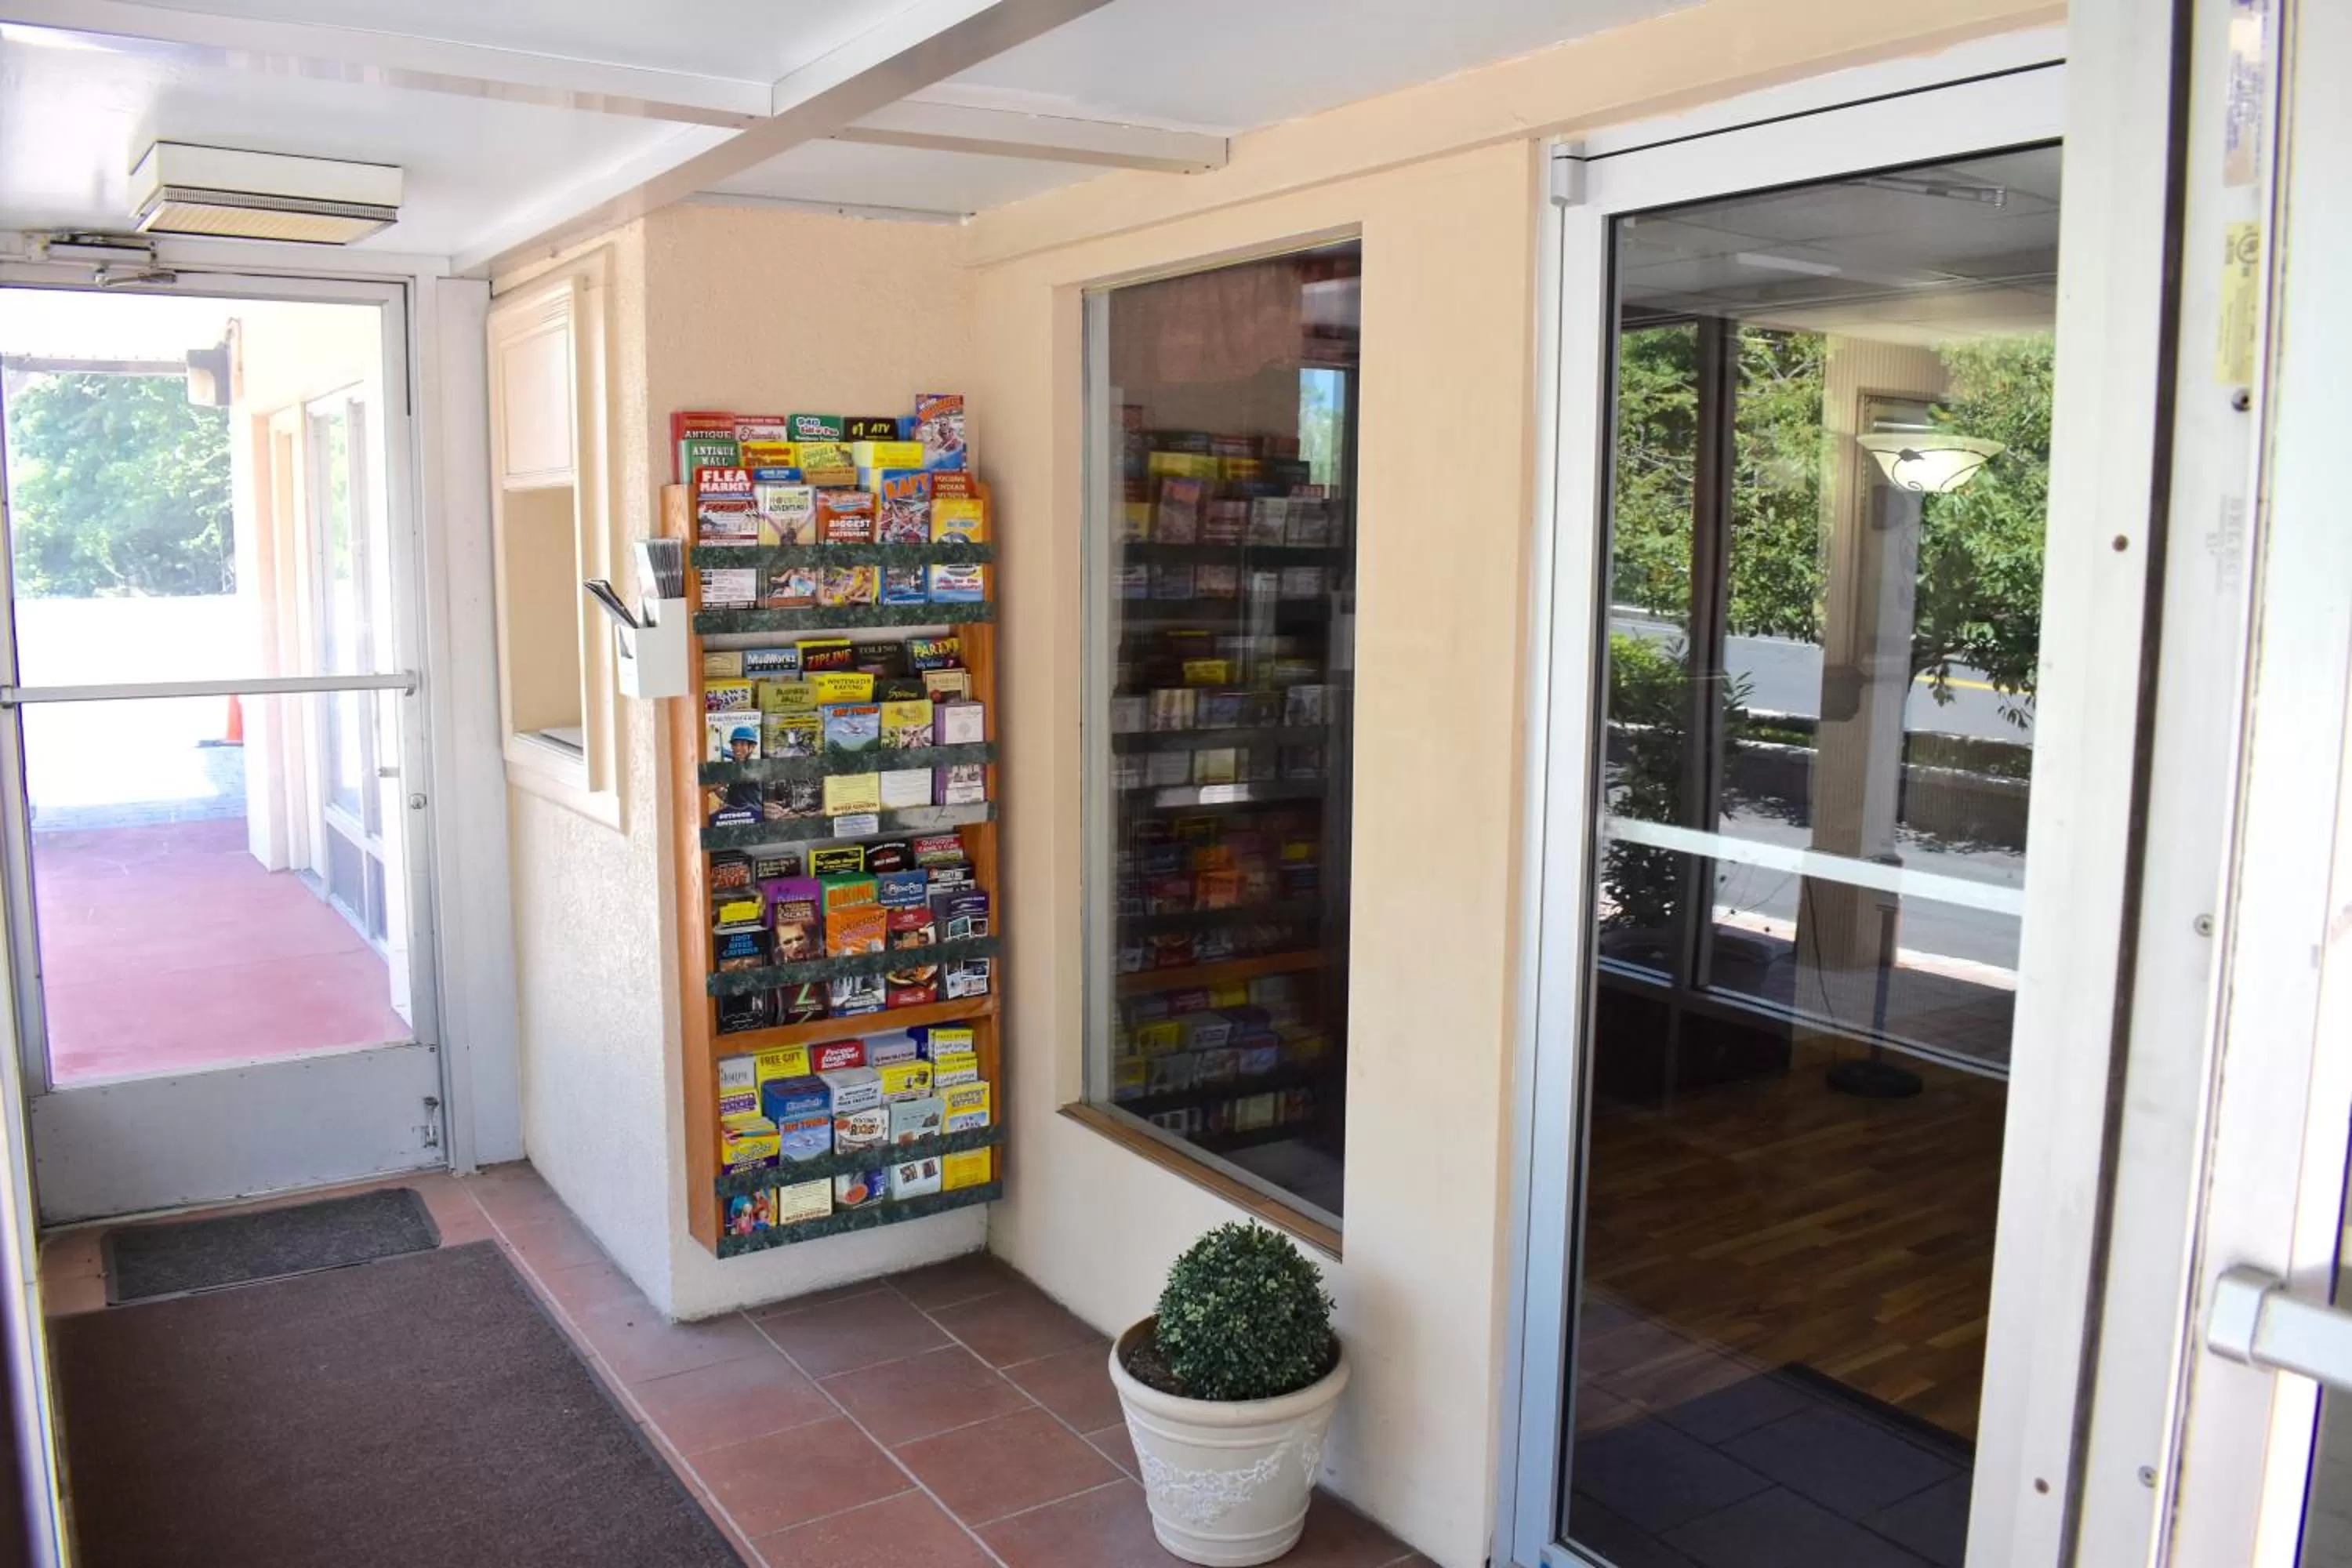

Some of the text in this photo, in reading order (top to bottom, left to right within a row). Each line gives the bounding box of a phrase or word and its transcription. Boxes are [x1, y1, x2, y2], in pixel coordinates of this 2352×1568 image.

[871, 423, 891, 433] ATV
[685, 430, 731, 439] ANTIQUE
[693, 446, 734, 456] ANTIQUE
[702, 470, 749, 481] FLEA
[699, 482, 751, 492] MARKET
[885, 473, 929, 499] RAFT
[829, 520, 870, 528] BIGGEST
[760, 1052, 801, 1066] FREE GIFT
